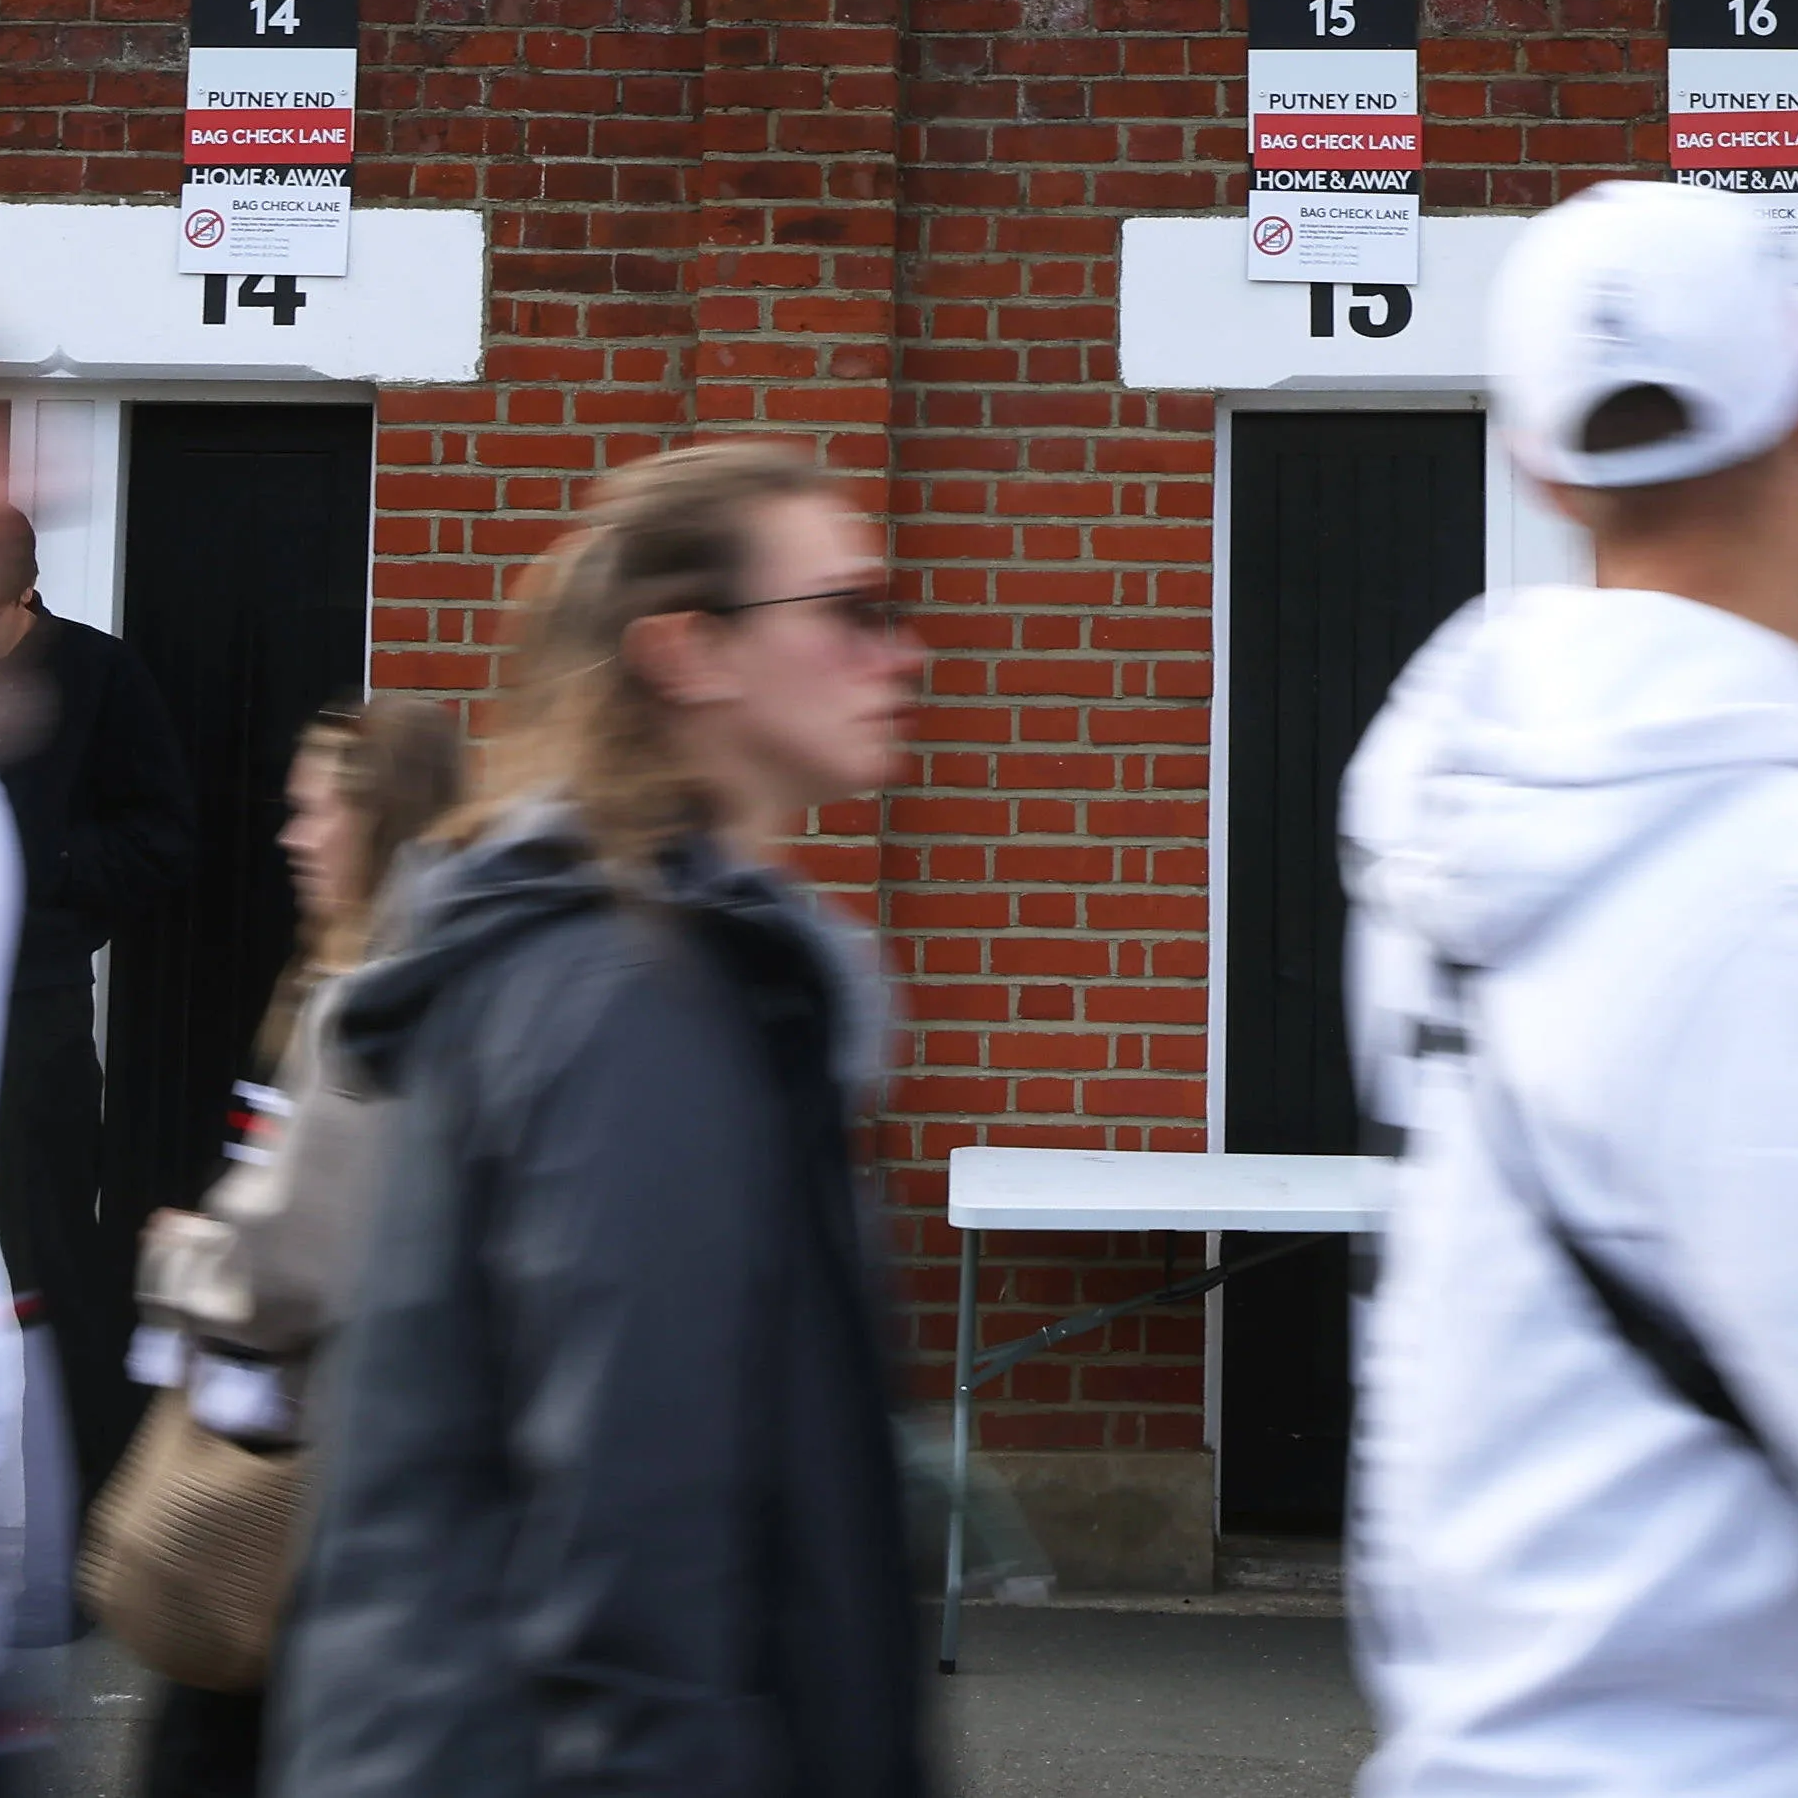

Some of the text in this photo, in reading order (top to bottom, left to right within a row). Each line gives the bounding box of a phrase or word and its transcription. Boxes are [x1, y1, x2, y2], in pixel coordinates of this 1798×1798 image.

[208, 91, 335, 107] PUTNEY END
[1269, 93, 1397, 110] PUTNEY END
[1689, 92, 1771, 110] PUTNEY
[191, 128, 346, 145] BAG CHECK LANE
[1260, 133, 1416, 151] BAG CHECK LANE
[1676, 132, 1714, 149] BAG
[1717, 131, 1780, 148] CHECK
[232, 199, 341, 213] BAG CHECK LANE
[1300, 207, 1409, 221] BAG CHECK LANE
[202, 275, 307, 326] 14
[1309, 283, 1413, 339] 15
